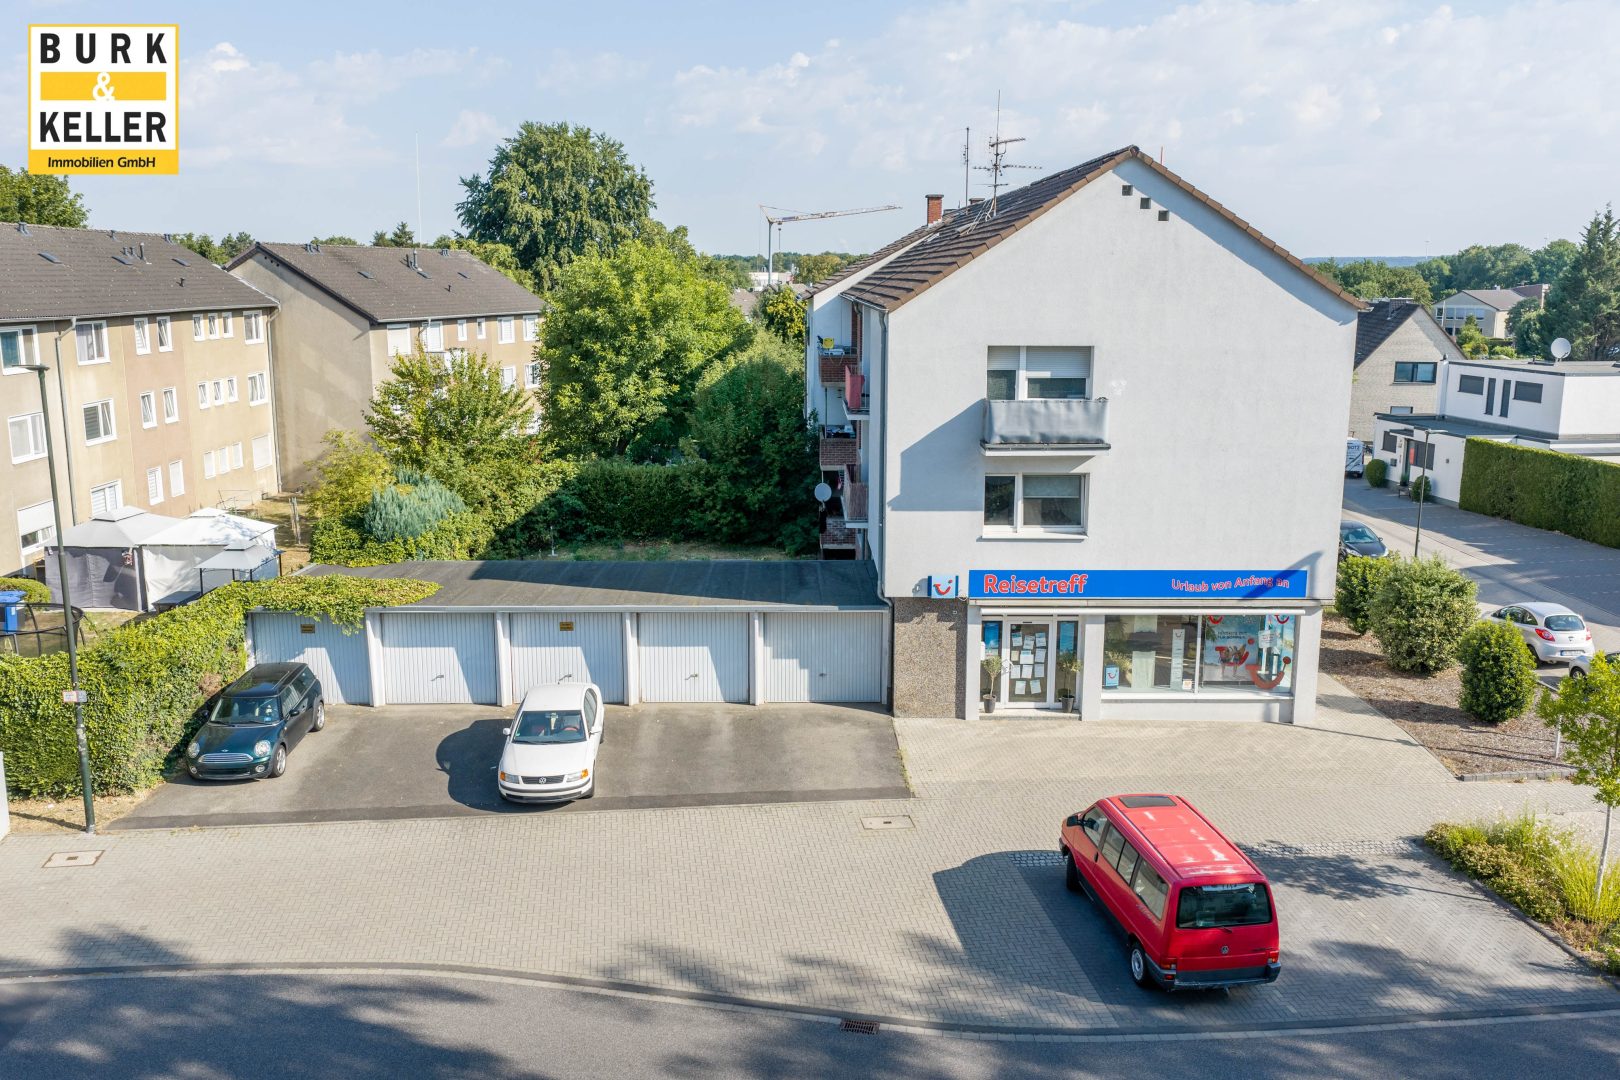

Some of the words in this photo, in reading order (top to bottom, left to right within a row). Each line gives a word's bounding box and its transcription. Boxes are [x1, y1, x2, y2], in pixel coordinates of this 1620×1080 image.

[983, 573, 1089, 594] Reisetreff
[1171, 578, 1209, 592] Urlaub
[1211, 580, 1232, 591] von
[1234, 575, 1274, 588] Anfang
[1276, 577, 1290, 589] an
